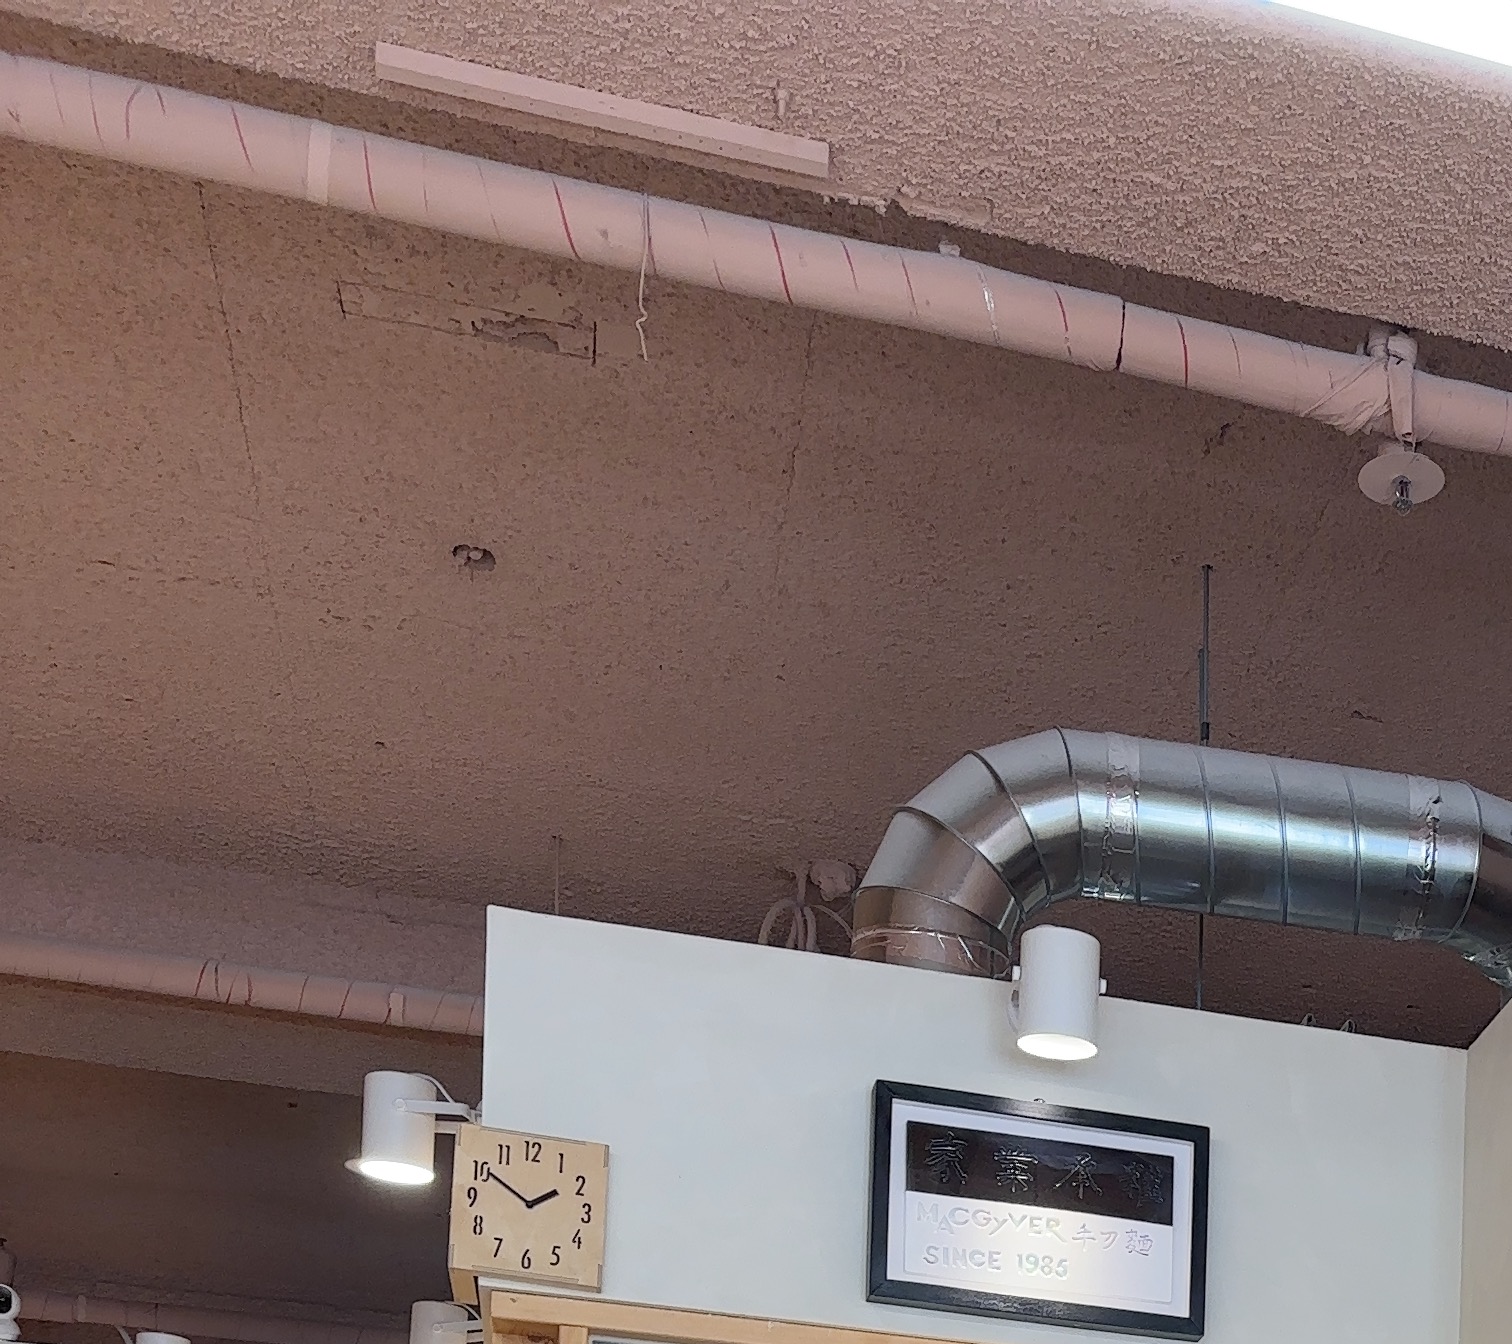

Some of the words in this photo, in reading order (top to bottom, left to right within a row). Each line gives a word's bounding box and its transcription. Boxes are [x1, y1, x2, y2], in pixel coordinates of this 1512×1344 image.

[498, 1144, 511, 1166] 11
[524, 1140, 542, 1163] 12
[472, 1160, 491, 1182] 10
[558, 1153, 564, 1174] 1
[575, 1175, 586, 1197] 2
[467, 1187, 478, 1208] 9
[581, 1203, 592, 1224] 3
[473, 1215, 483, 1236] 8
[494, 1237, 503, 1258] 7
[572, 1229, 582, 1250] 4
[522, 1249, 531, 1270] 6
[550, 1246, 561, 1266] 5
[922, 1245, 1004, 1272] SINCE
[1015, 1252, 1070, 1280] 1985
